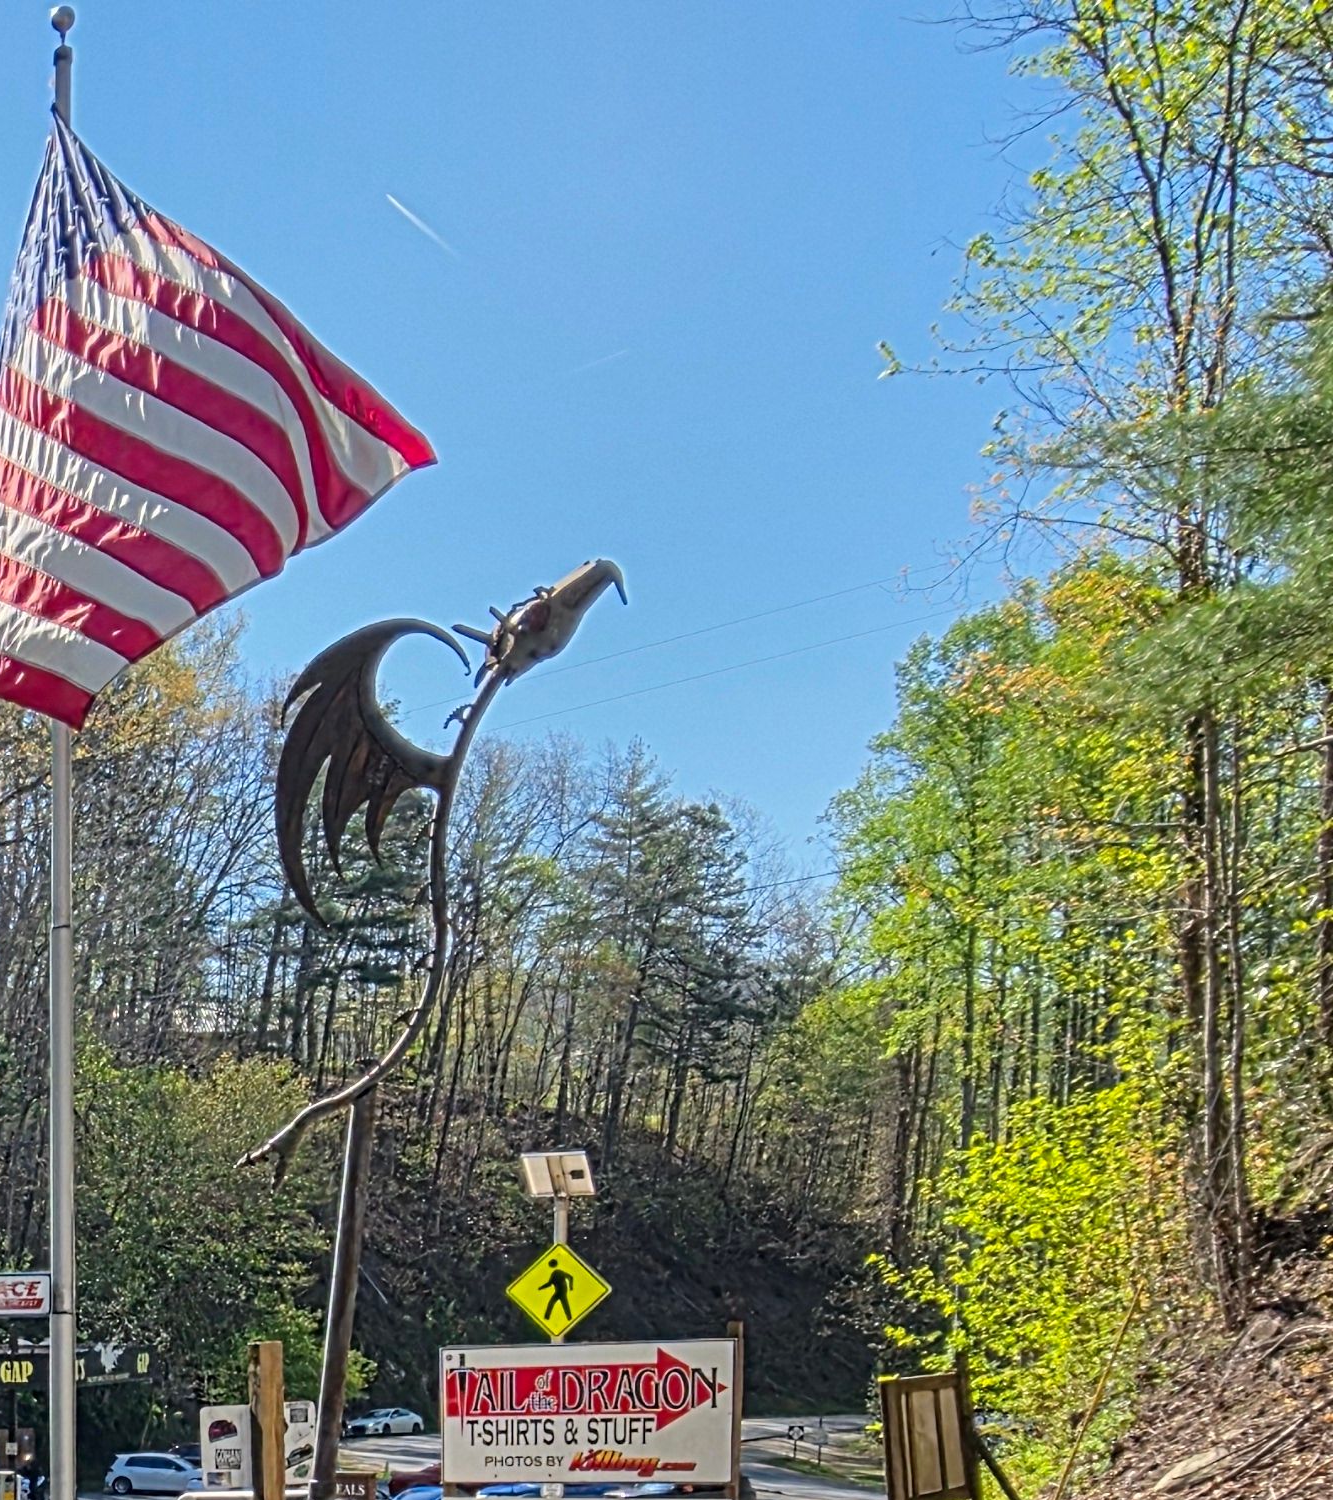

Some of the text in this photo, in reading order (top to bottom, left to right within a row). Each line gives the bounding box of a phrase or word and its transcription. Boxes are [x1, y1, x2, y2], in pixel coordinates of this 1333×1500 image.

[0, 1360, 34, 1383] GAP
[446, 1357, 528, 1428] TAIL
[535, 1370, 553, 1391] of
[559, 1366, 718, 1413] DRAGON
[466, 1417, 656, 1446] T-SHIRTS & STUFF
[484, 1455, 542, 1468] PHOTOS
[546, 1455, 564, 1467] BY
